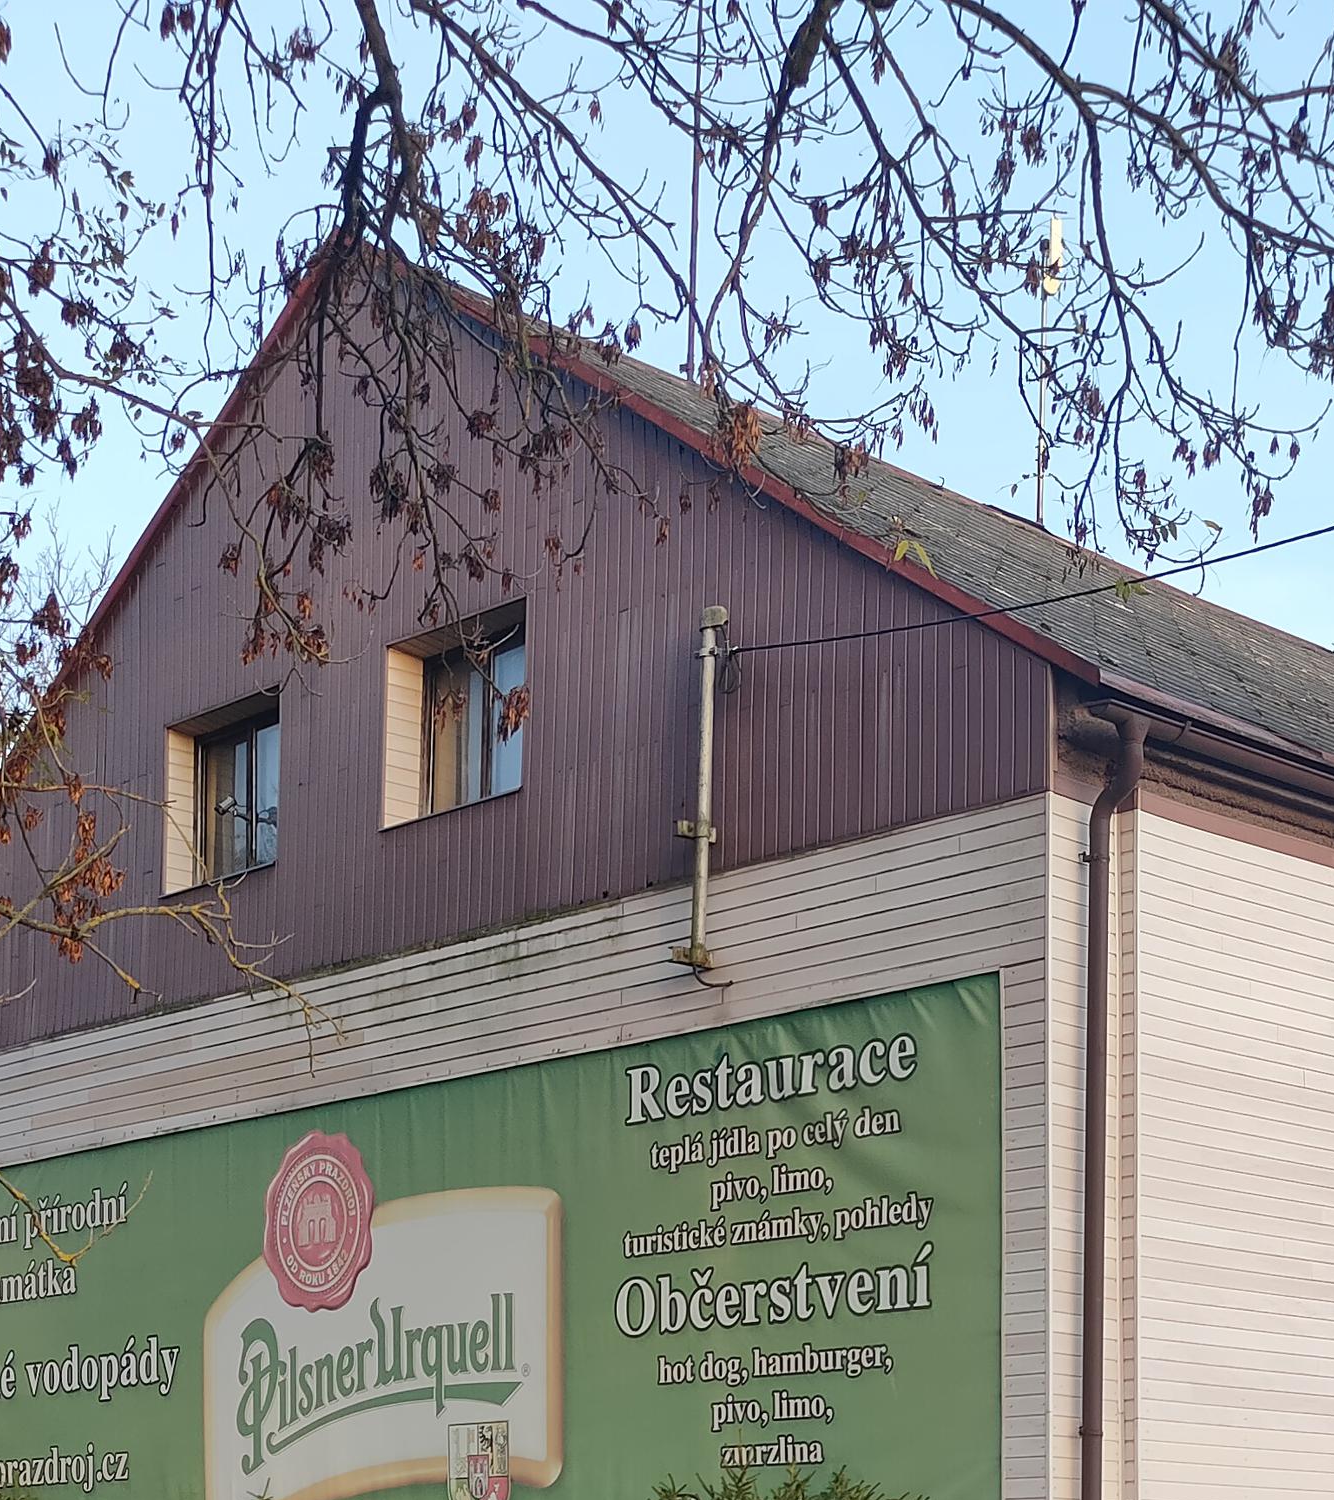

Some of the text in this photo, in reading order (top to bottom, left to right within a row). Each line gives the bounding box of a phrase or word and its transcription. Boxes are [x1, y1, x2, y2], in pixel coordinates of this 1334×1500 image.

[625, 1032, 917, 1125] Restaurace
[650, 1107, 900, 1172] teplá jídla po celý den
[23, 1181, 129, 1249] přírodní
[318, 1160, 356, 1217] PRAZDROJ
[711, 1165, 834, 1211] pivo, limo,
[623, 1192, 934, 1258] turistické známky, pohledy
[286, 1254, 298, 1273] OD
[298, 1269, 326, 1286] ROKU
[614, 1242, 934, 1340] Občerstvení
[24, 1335, 180, 1401] vodopády
[236, 1292, 516, 1476] Pilsner Urquell
[657, 1343, 893, 1386] hot dog, hamburger,
[711, 1390, 834, 1432] pivo, limo,
[721, 1435, 824, 1468] zmrzlina
